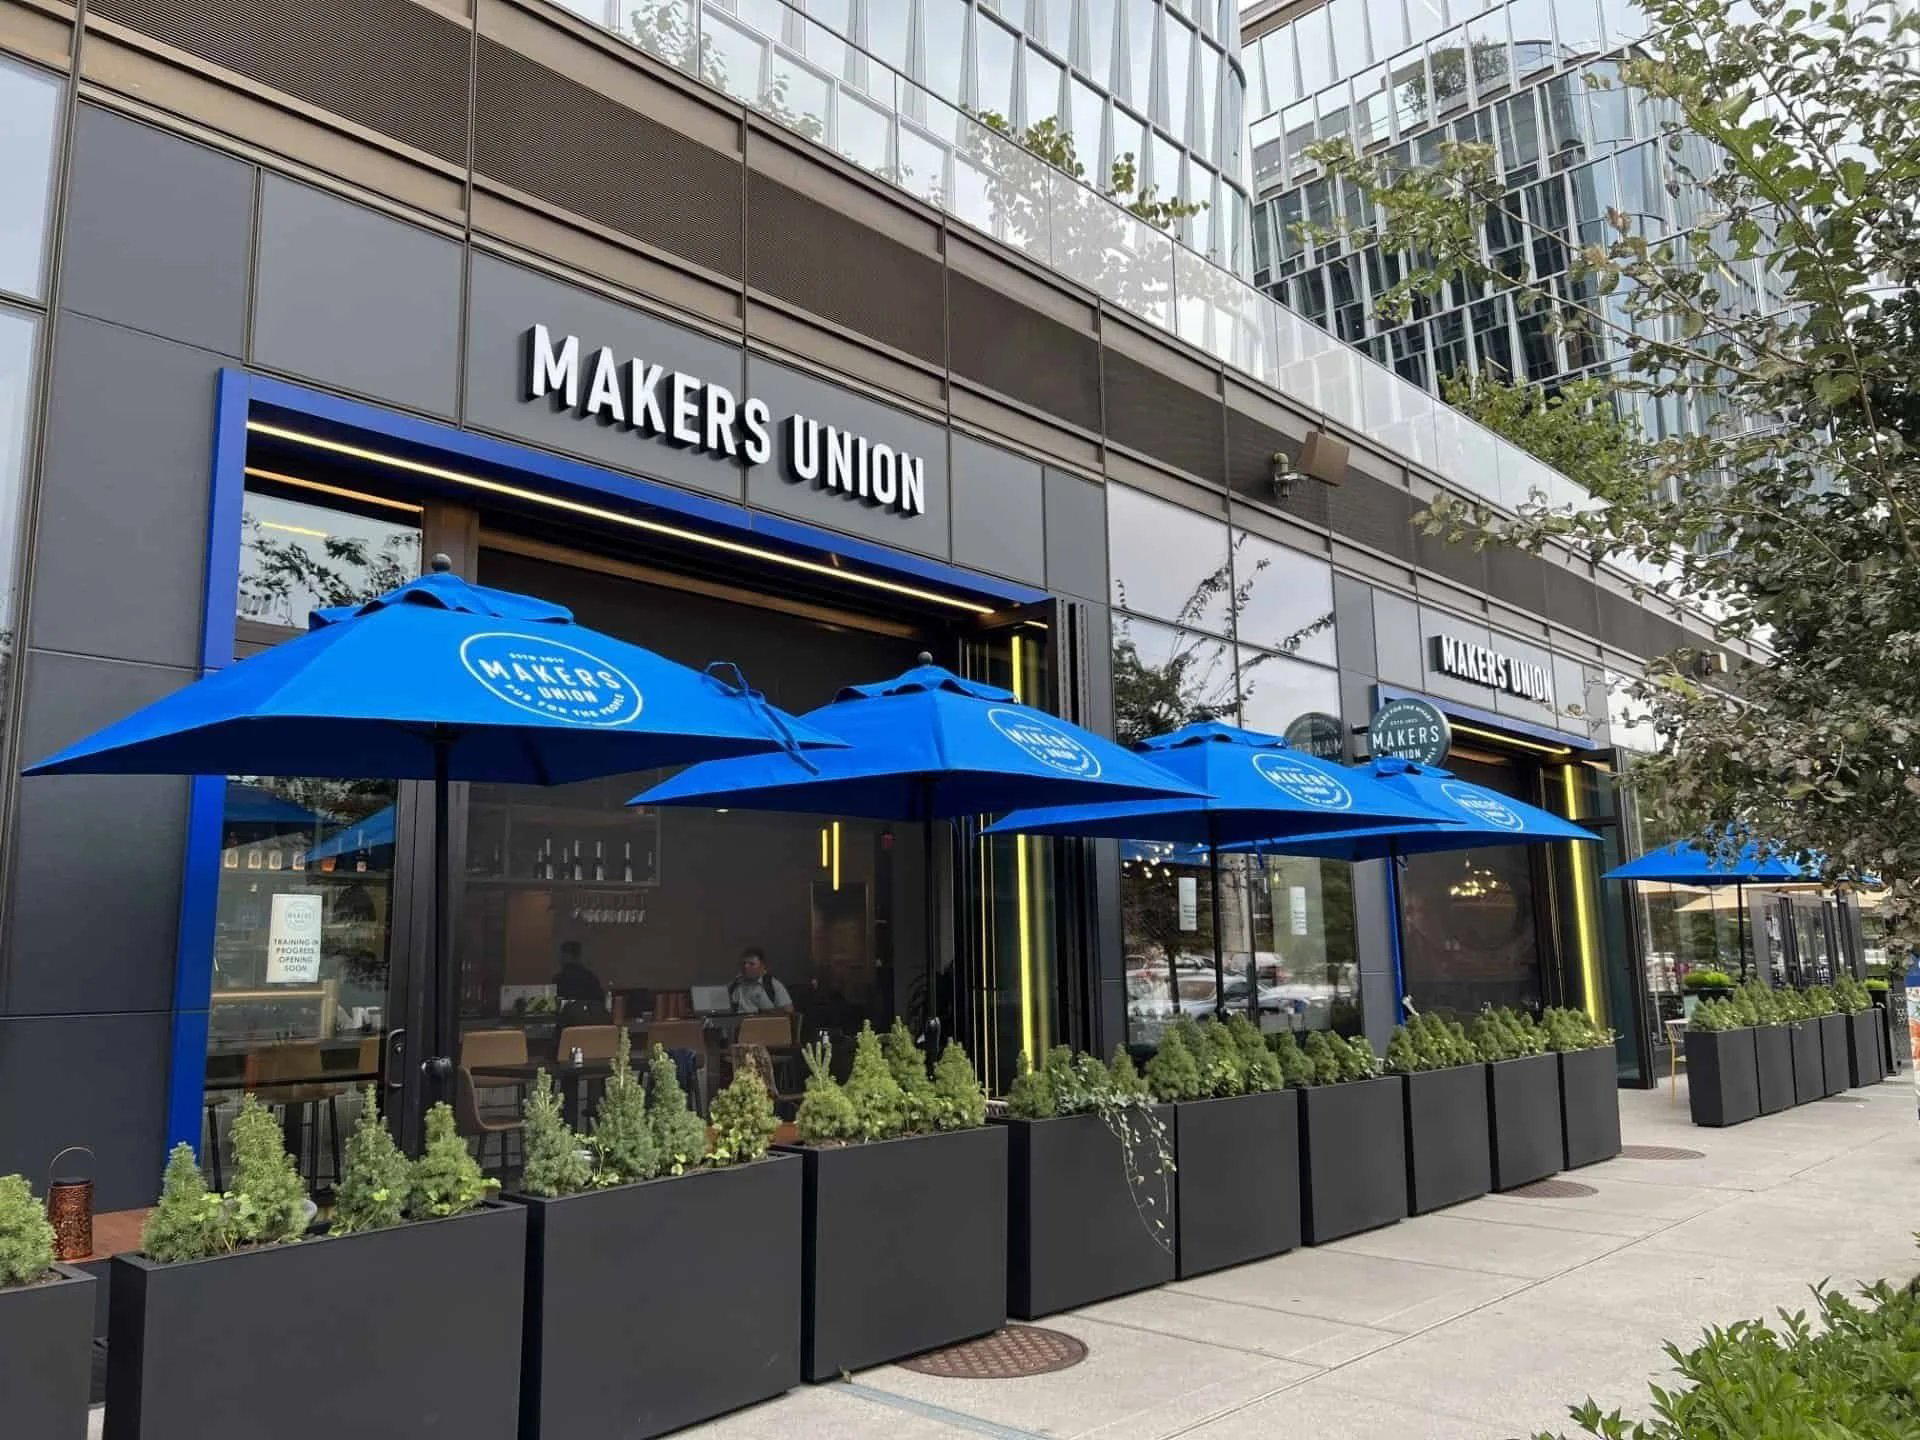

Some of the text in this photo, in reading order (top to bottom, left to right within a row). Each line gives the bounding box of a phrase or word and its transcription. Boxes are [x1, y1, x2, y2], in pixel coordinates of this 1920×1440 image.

[531, 323, 926, 515] MAKERS UNION
[478, 658, 622, 690] MAKERS
[1441, 632, 1553, 702] MAKERS UNION
[537, 685, 599, 703] UNION
[1372, 725, 1440, 750] MAKERS
[1392, 748, 1421, 760] UNION
[274, 938, 311, 946] TRAINING
[279, 955, 313, 963] OPENING
[285, 964, 307, 972] SOON
